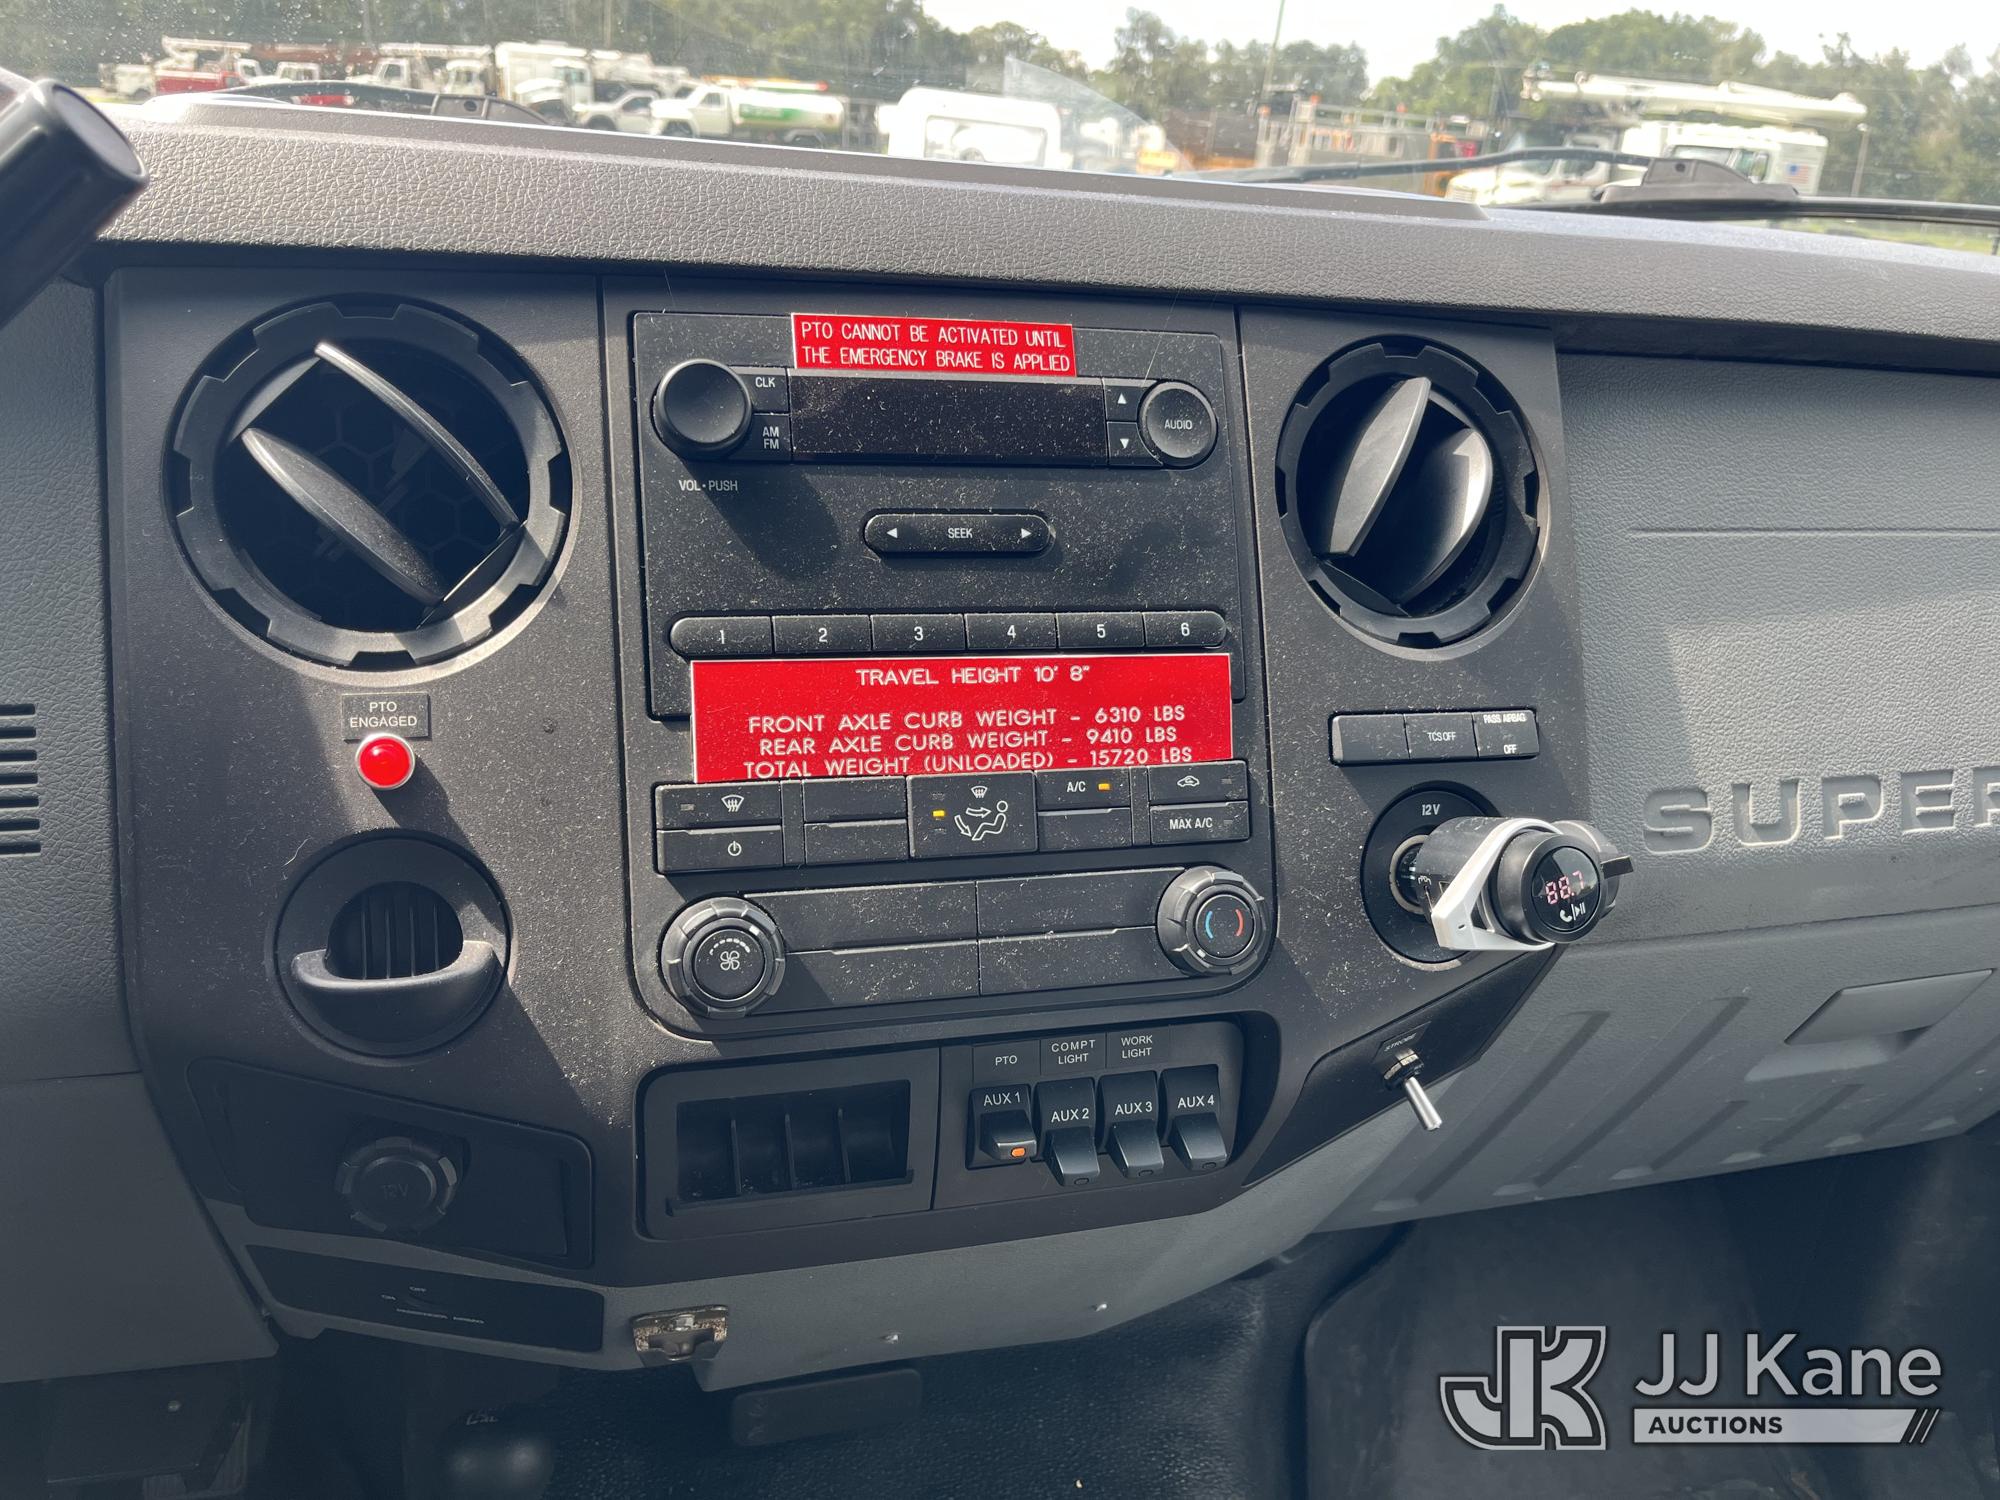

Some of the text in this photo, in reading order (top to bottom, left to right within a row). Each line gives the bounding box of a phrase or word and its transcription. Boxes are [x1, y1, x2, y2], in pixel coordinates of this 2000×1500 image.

[801, 322, 1066, 348] PTO CANNOT BE ACTIVATED UNTIL
[802, 346, 1070, 372] THE EMERGENCY BRAKE IS APPLIED
[755, 377, 776, 389] CLK
[1164, 418, 1194, 431] AUDIO
[762, 426, 779, 438] AM
[763, 439, 779, 450] FM
[708, 480, 738, 492] PUSH
[948, 527, 973, 539] SEEK
[818, 627, 828, 643] 2
[914, 626, 924, 642] 3
[1007, 624, 1017, 640] 4
[1096, 623, 1106, 639] 5
[1180, 621, 1191, 637] 6
[719, 630, 725, 645] 1
[856, 665, 1091, 686] TRAVEL HEIGHT 10' 8"
[369, 701, 397, 712] PTO
[349, 716, 418, 728] ENGAGED
[748, 715, 825, 734] FRONT
[838, 713, 892, 731] AXLE
[904, 712, 963, 729] CURB
[977, 709, 1057, 727] WEIGHT
[1095, 707, 1141, 724] 6310
[1154, 706, 1185, 721] LBS
[760, 737, 817, 755] REAR
[829, 735, 882, 753] AXLE
[894, 733, 954, 751] CURB
[968, 731, 1048, 749] WEIGHT
[1086, 729, 1133, 745] 9410
[1145, 727, 1177, 743] LBS
[1427, 730, 1456, 742] TCS OFF
[1504, 743, 1518, 754] OFF
[744, 761, 812, 780] TOTAL
[825, 758, 910, 776] WEIGHT
[923, 753, 1055, 773] (UNLOADED)
[1090, 750, 1148, 767] 15720
[1161, 748, 1193, 764] LBS
[1066, 781, 1086, 794] A/C
[1421, 803, 1440, 816] 12V
[1169, 816, 1213, 830] MAX A/C
[1051, 1039, 1096, 1052] COMPT
[1121, 1034, 1153, 1046] WORK
[1058, 1053, 1089, 1065] LIGHT
[1122, 1047, 1152, 1059] LIGHT
[995, 1055, 1018, 1066] PTO
[983, 1092, 1021, 1107] AUX 1
[1177, 1095, 1215, 1109] AUX 4
[1115, 1101, 1153, 1115] AUX 3
[1051, 1107, 1090, 1123] AUX 2
